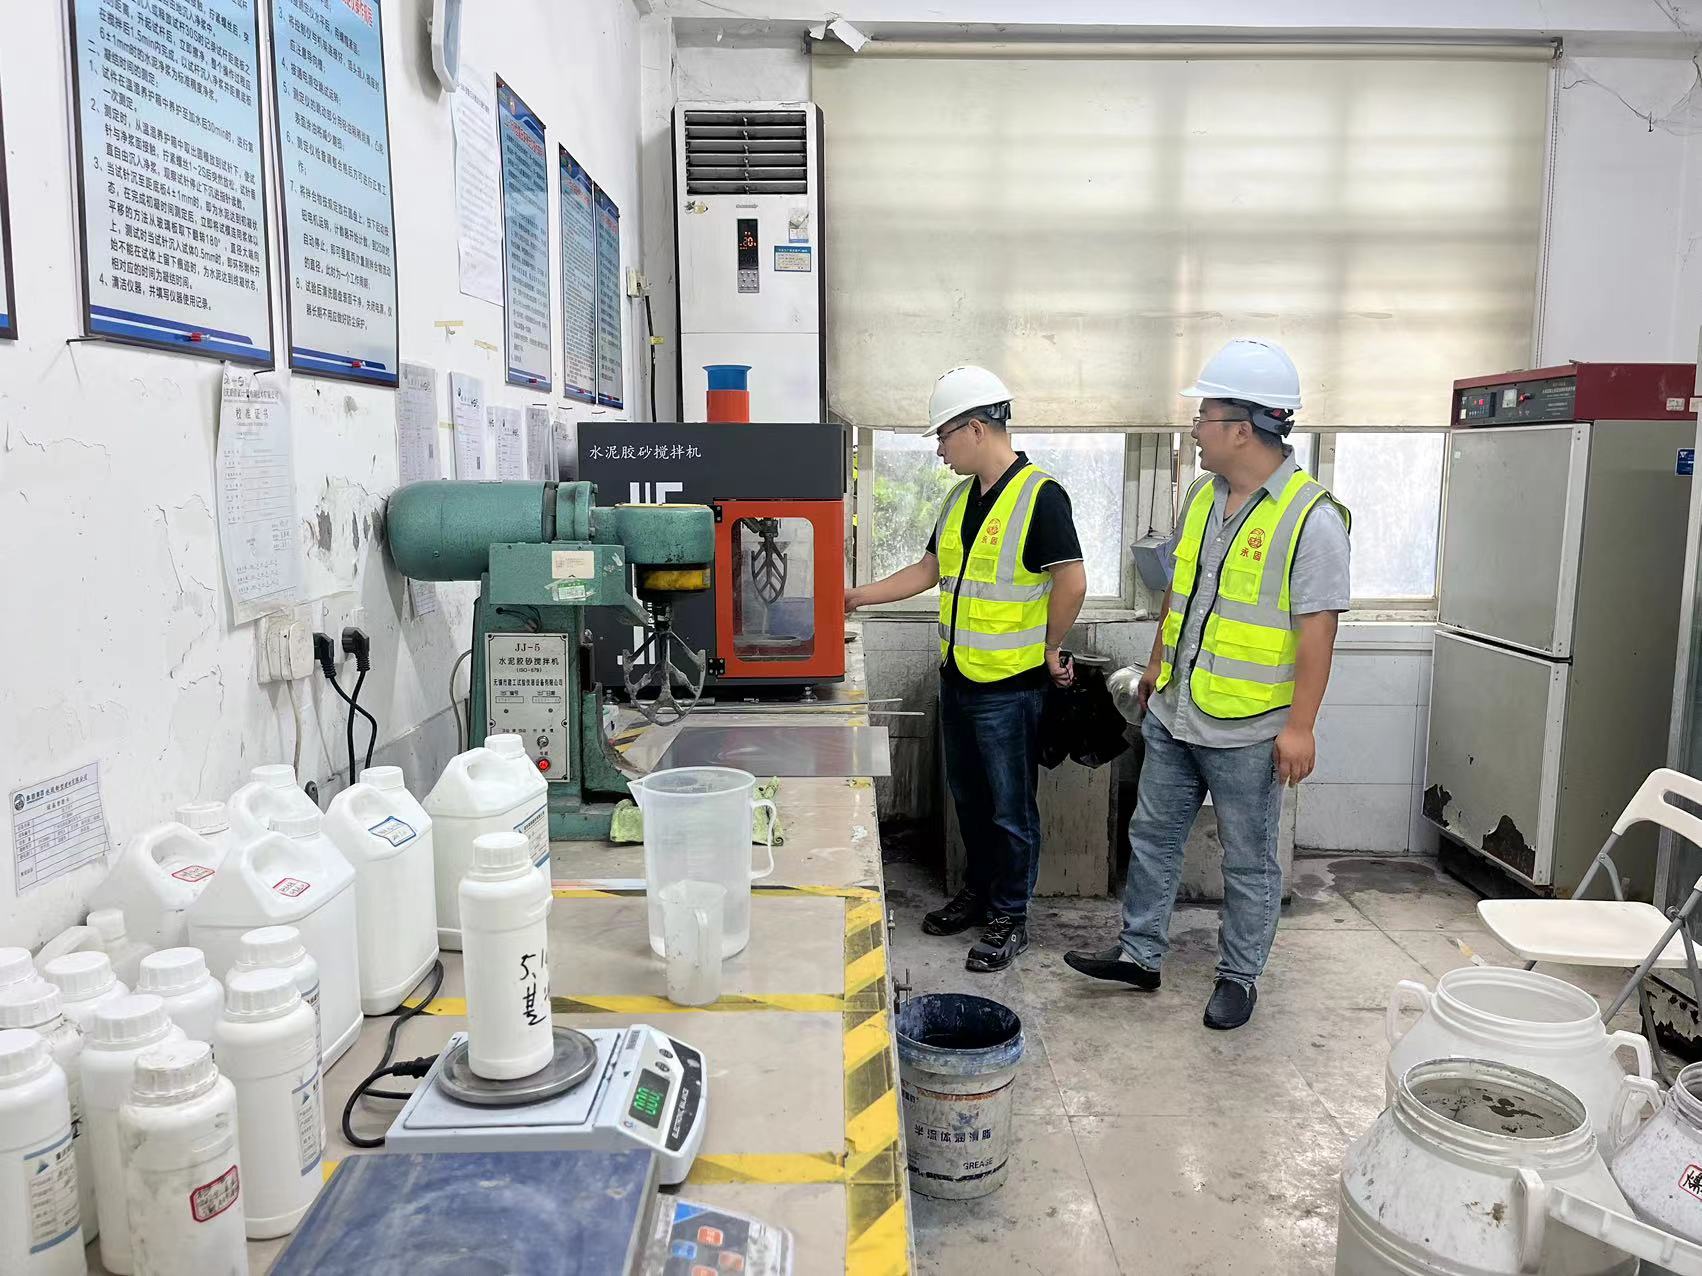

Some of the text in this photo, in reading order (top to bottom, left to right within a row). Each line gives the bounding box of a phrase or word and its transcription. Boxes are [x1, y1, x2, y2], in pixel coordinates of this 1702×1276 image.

[590, 445, 702, 460] 水泥胶砂搅拌机
[1240, 547, 1262, 562] 永固
[514, 643, 541, 652] JJ-5
[498, 657, 560, 666] 水泥胶砂搅拌机
[963, 1157, 993, 1170] GREASE
